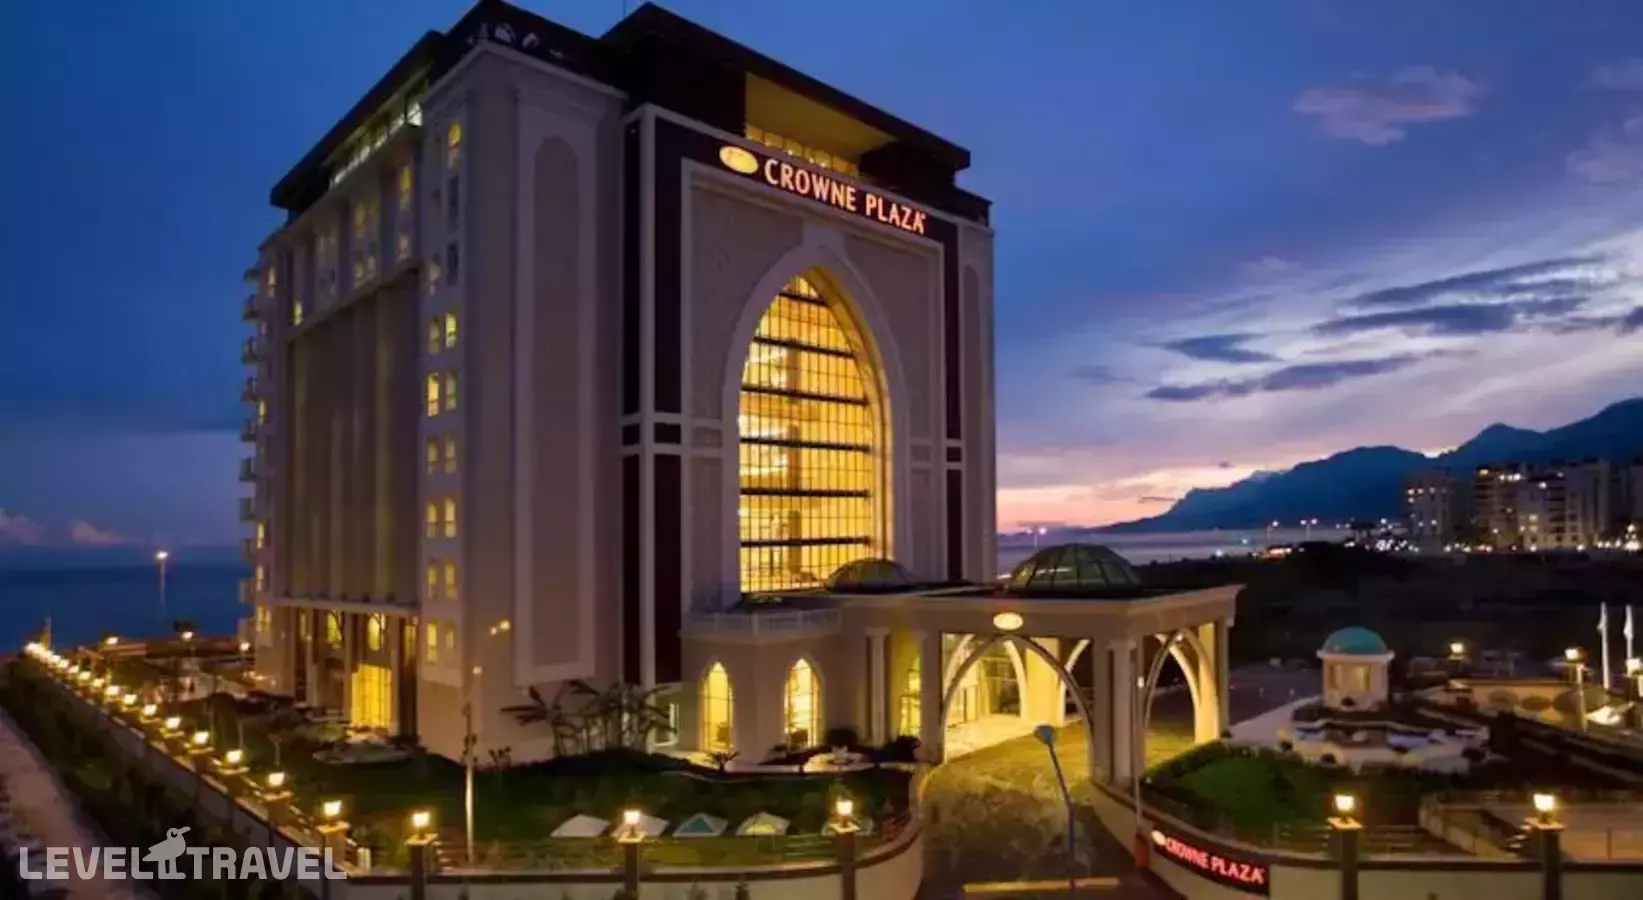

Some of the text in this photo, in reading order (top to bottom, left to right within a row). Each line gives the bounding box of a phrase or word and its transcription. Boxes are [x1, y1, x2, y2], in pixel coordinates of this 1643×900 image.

[764, 159, 926, 234] CROWNE PLAZA
[1211, 855, 1264, 884] PLAZA
